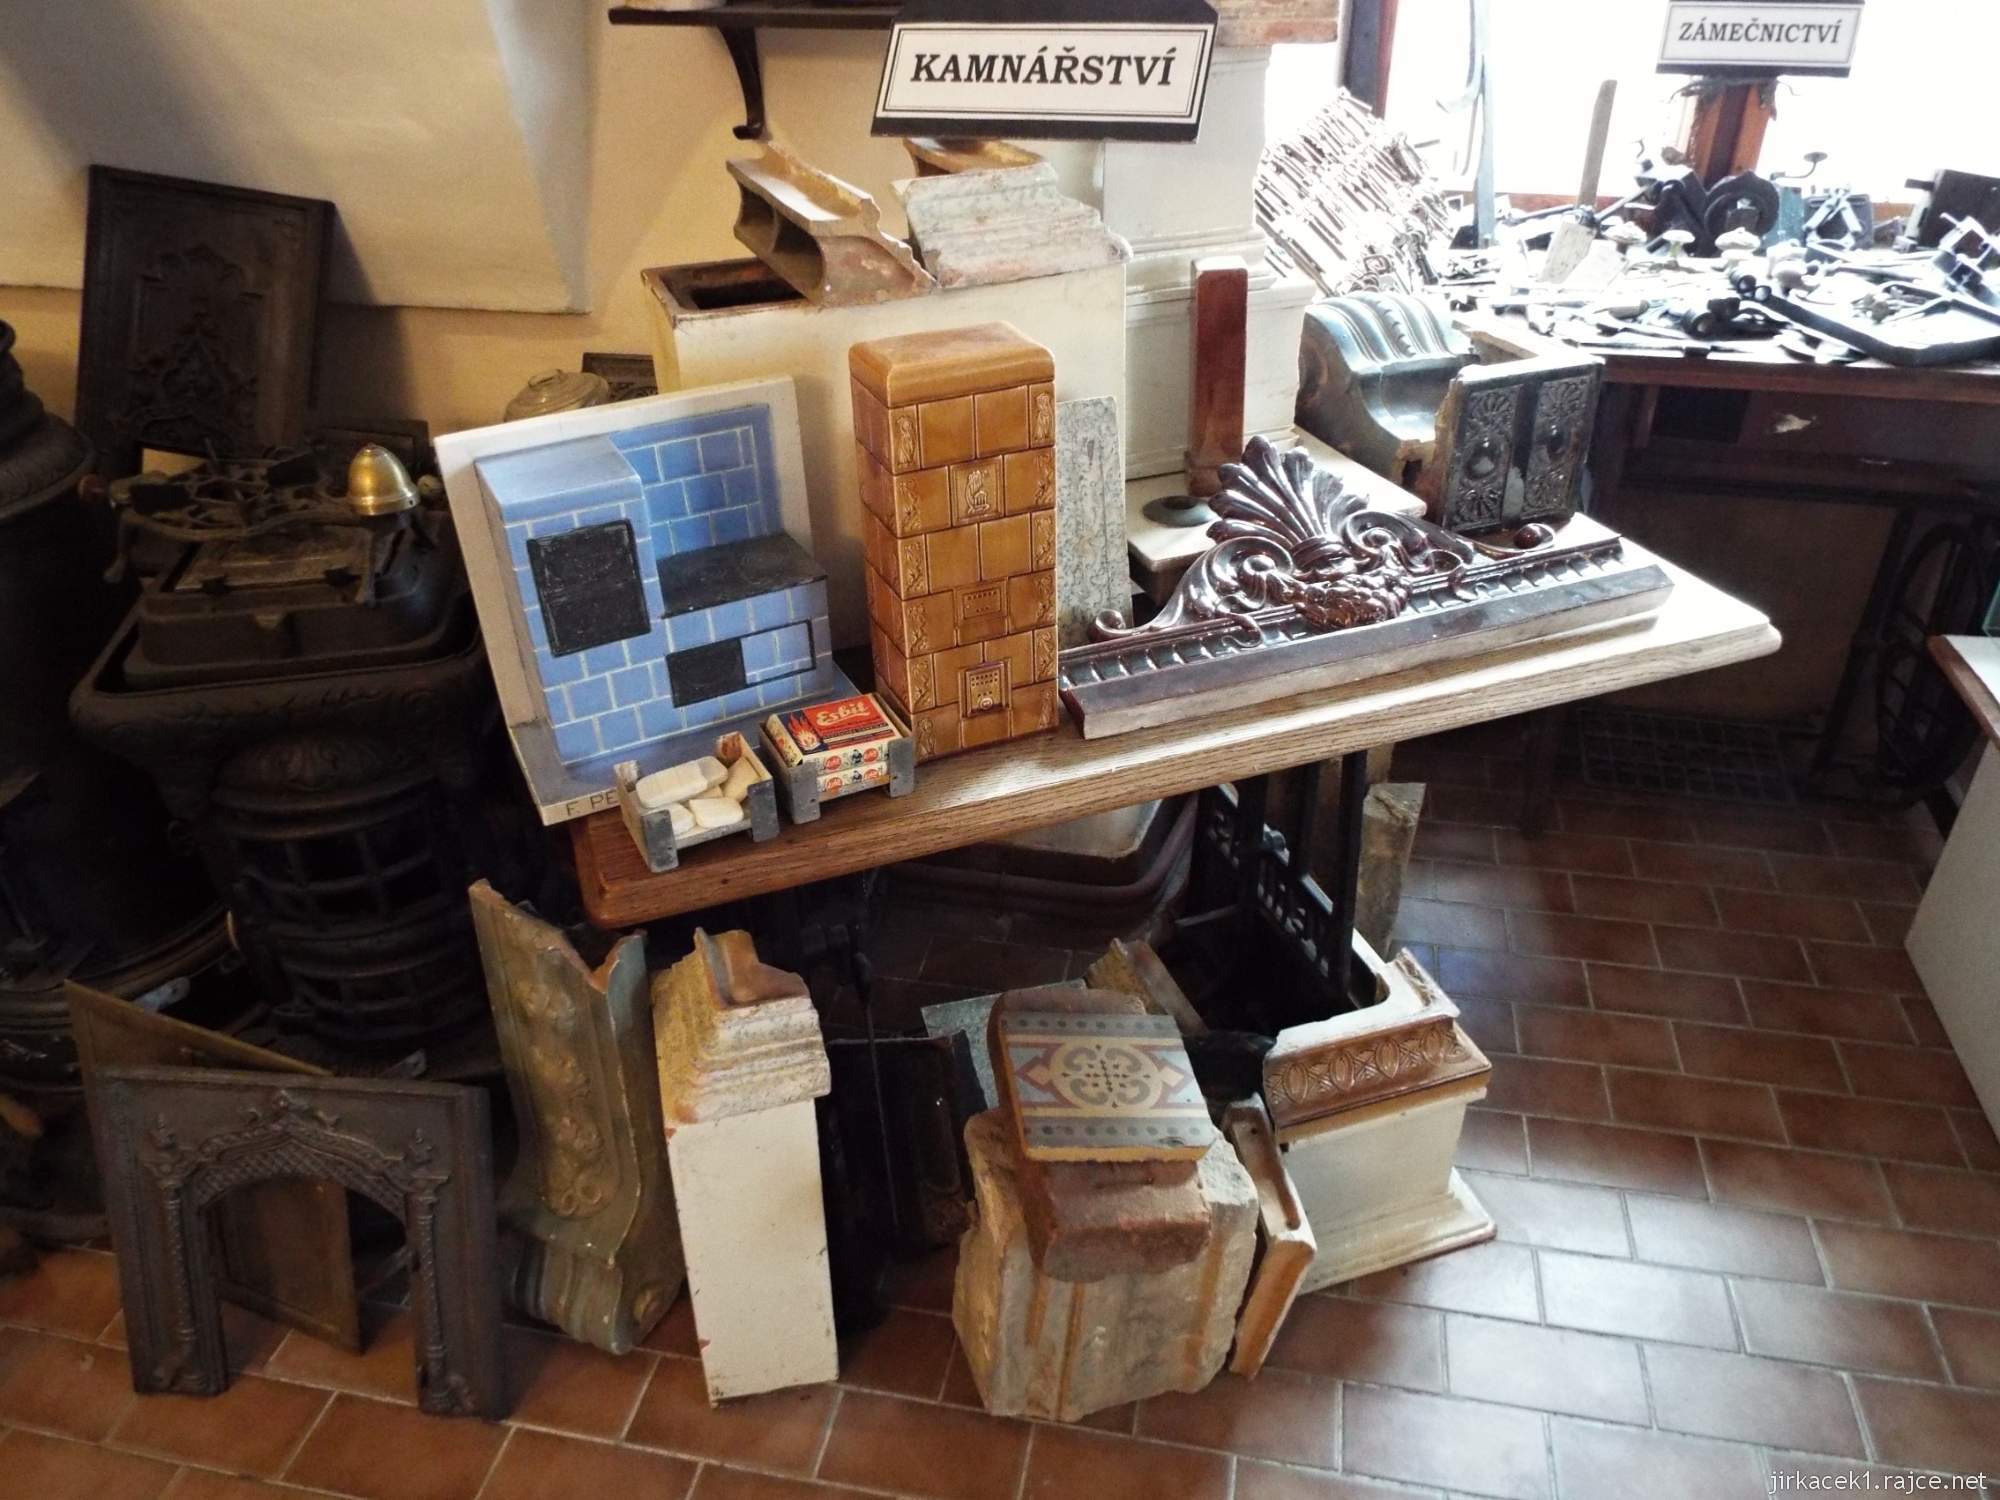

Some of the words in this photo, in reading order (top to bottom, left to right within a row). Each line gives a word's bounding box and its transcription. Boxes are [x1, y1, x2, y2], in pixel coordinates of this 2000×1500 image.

[1678, 17, 1842, 43] ZÁMEČNICTVÍ
[910, 45, 1177, 86] KAMNÁŘSTVÍ
[817, 701, 870, 726] Esbit
